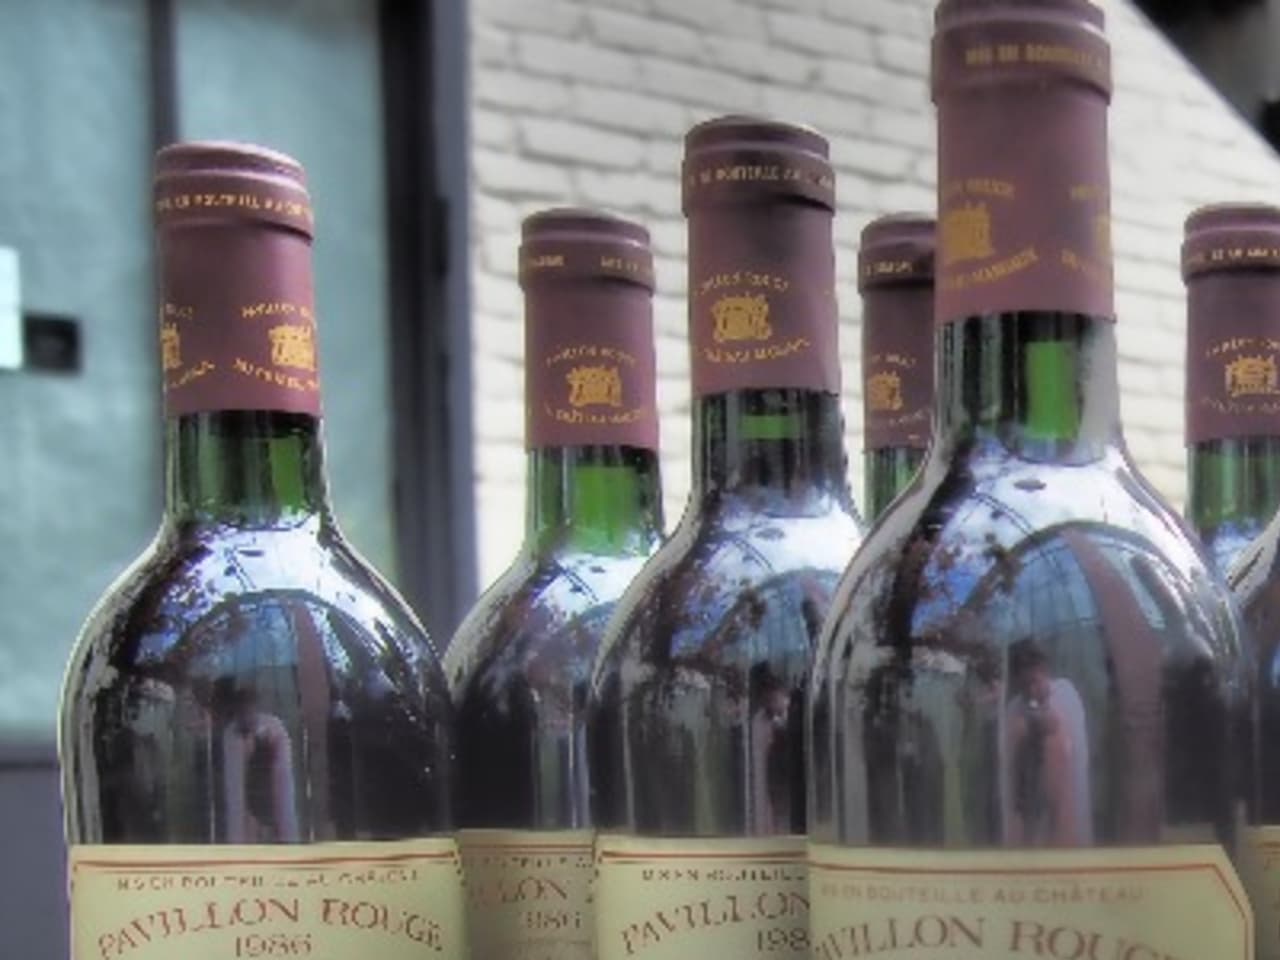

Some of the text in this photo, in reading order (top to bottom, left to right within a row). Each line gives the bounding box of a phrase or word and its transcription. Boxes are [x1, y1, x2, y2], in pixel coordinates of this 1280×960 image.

[321, 897, 444, 952] ROUGE
[235, 933, 314, 957] 1986
[756, 926, 811, 951] 198
